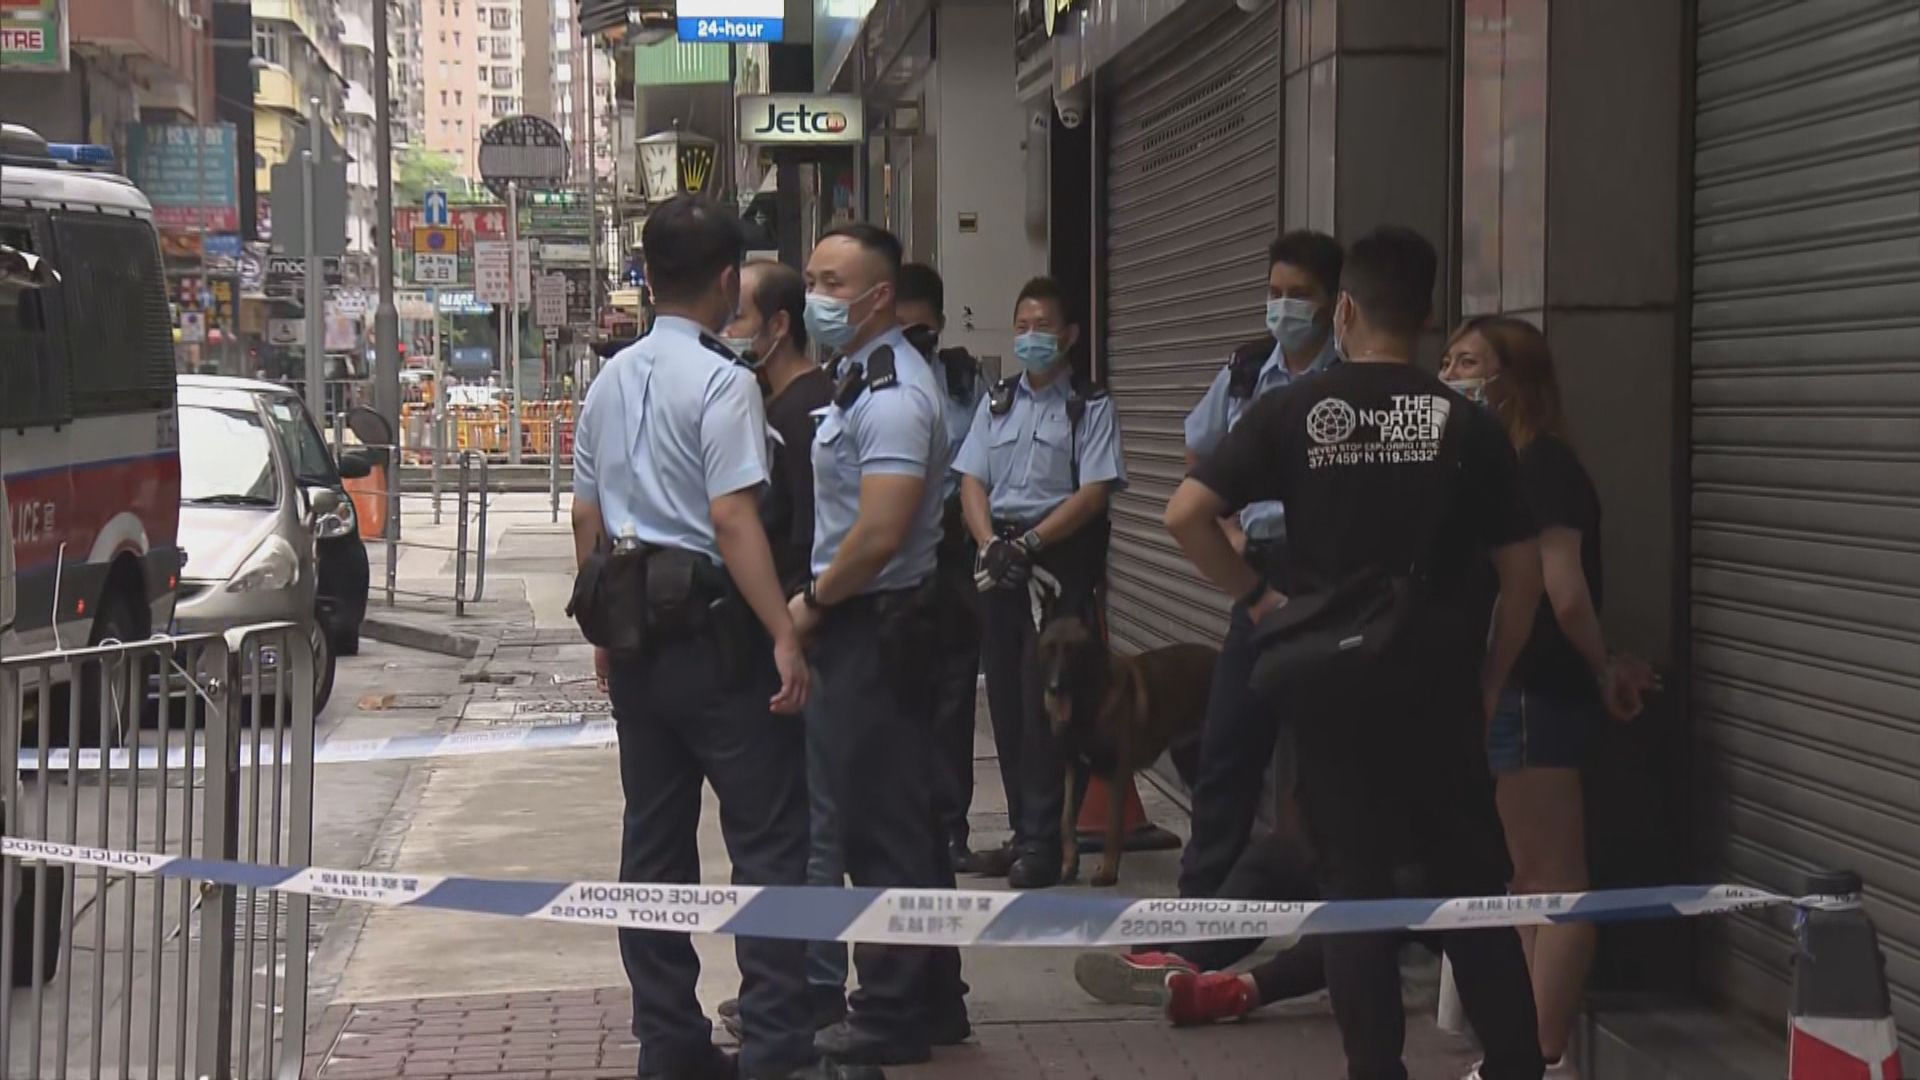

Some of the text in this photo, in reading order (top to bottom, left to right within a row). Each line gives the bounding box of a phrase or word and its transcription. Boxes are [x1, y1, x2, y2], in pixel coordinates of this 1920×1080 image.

[697, 19, 764, 37] 24-hour
[1391, 394, 1431, 410] THE
[1359, 409, 1430, 427] NORTH
[1380, 425, 1430, 442] FACE
